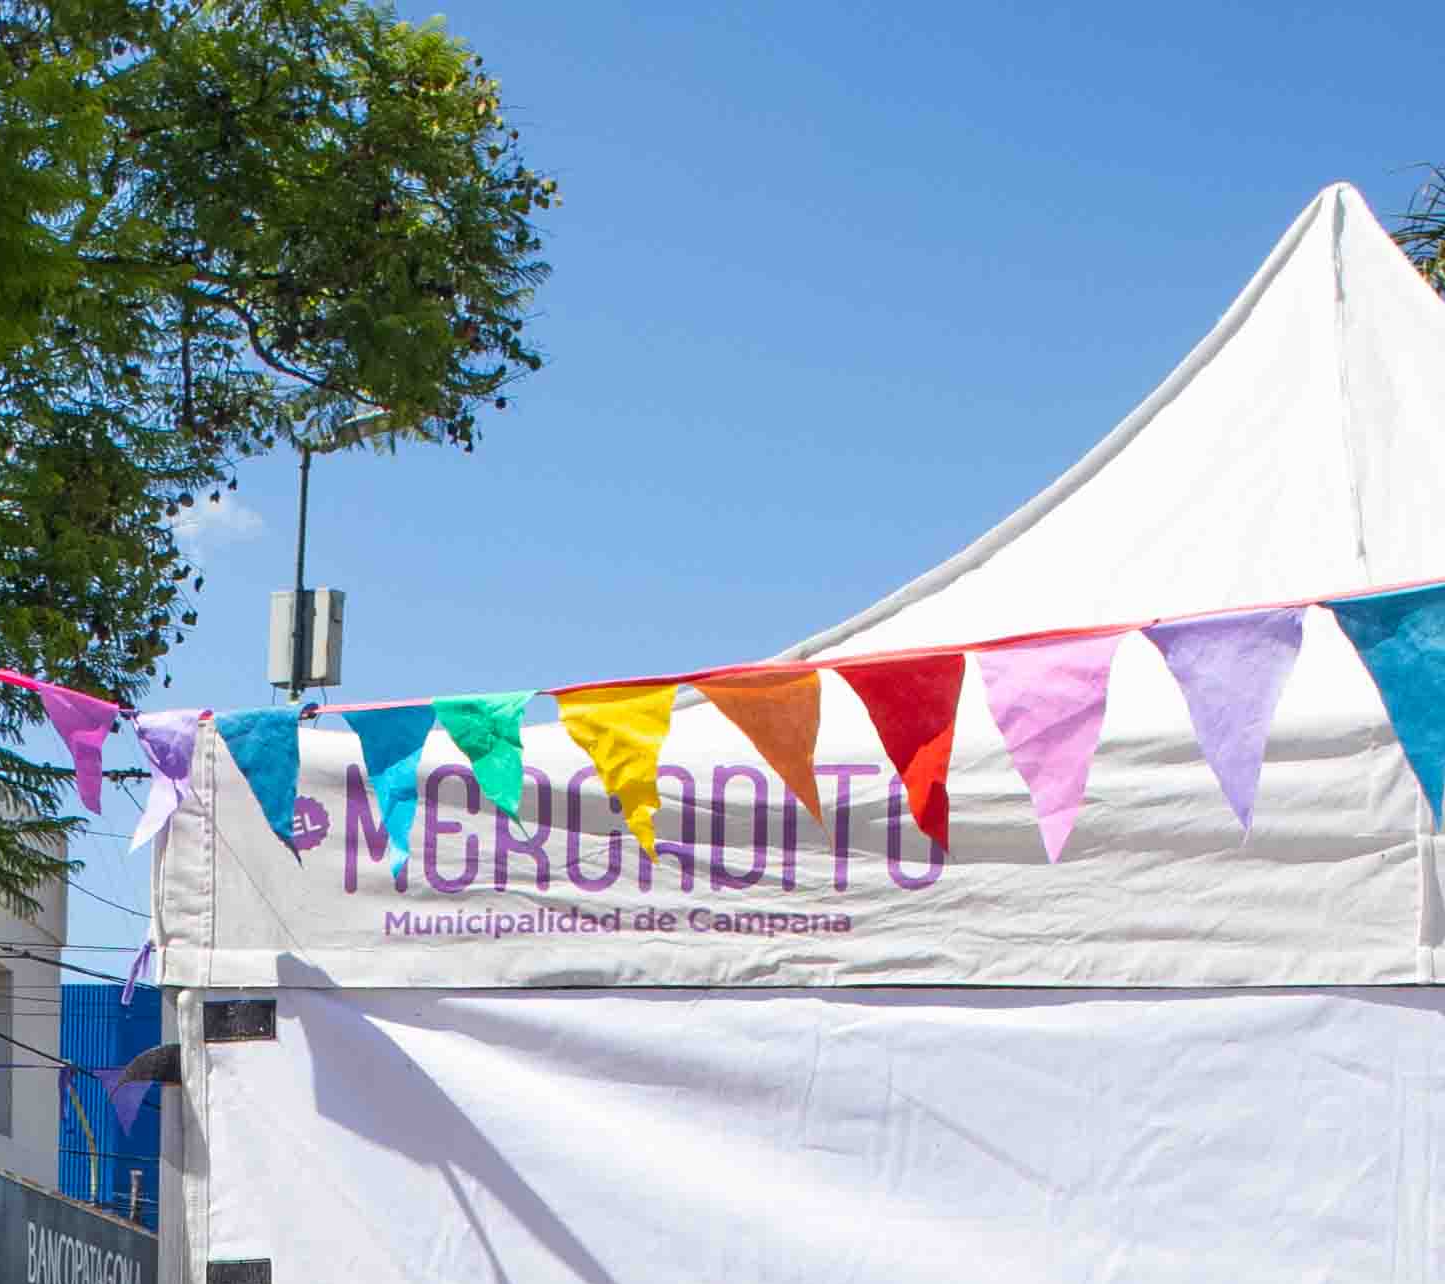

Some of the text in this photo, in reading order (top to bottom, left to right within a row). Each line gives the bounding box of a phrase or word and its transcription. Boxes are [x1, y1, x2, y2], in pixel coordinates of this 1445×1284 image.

[289, 763, 947, 894] EL MERCADITO
[385, 907, 854, 938] Municipalidad de Campana
